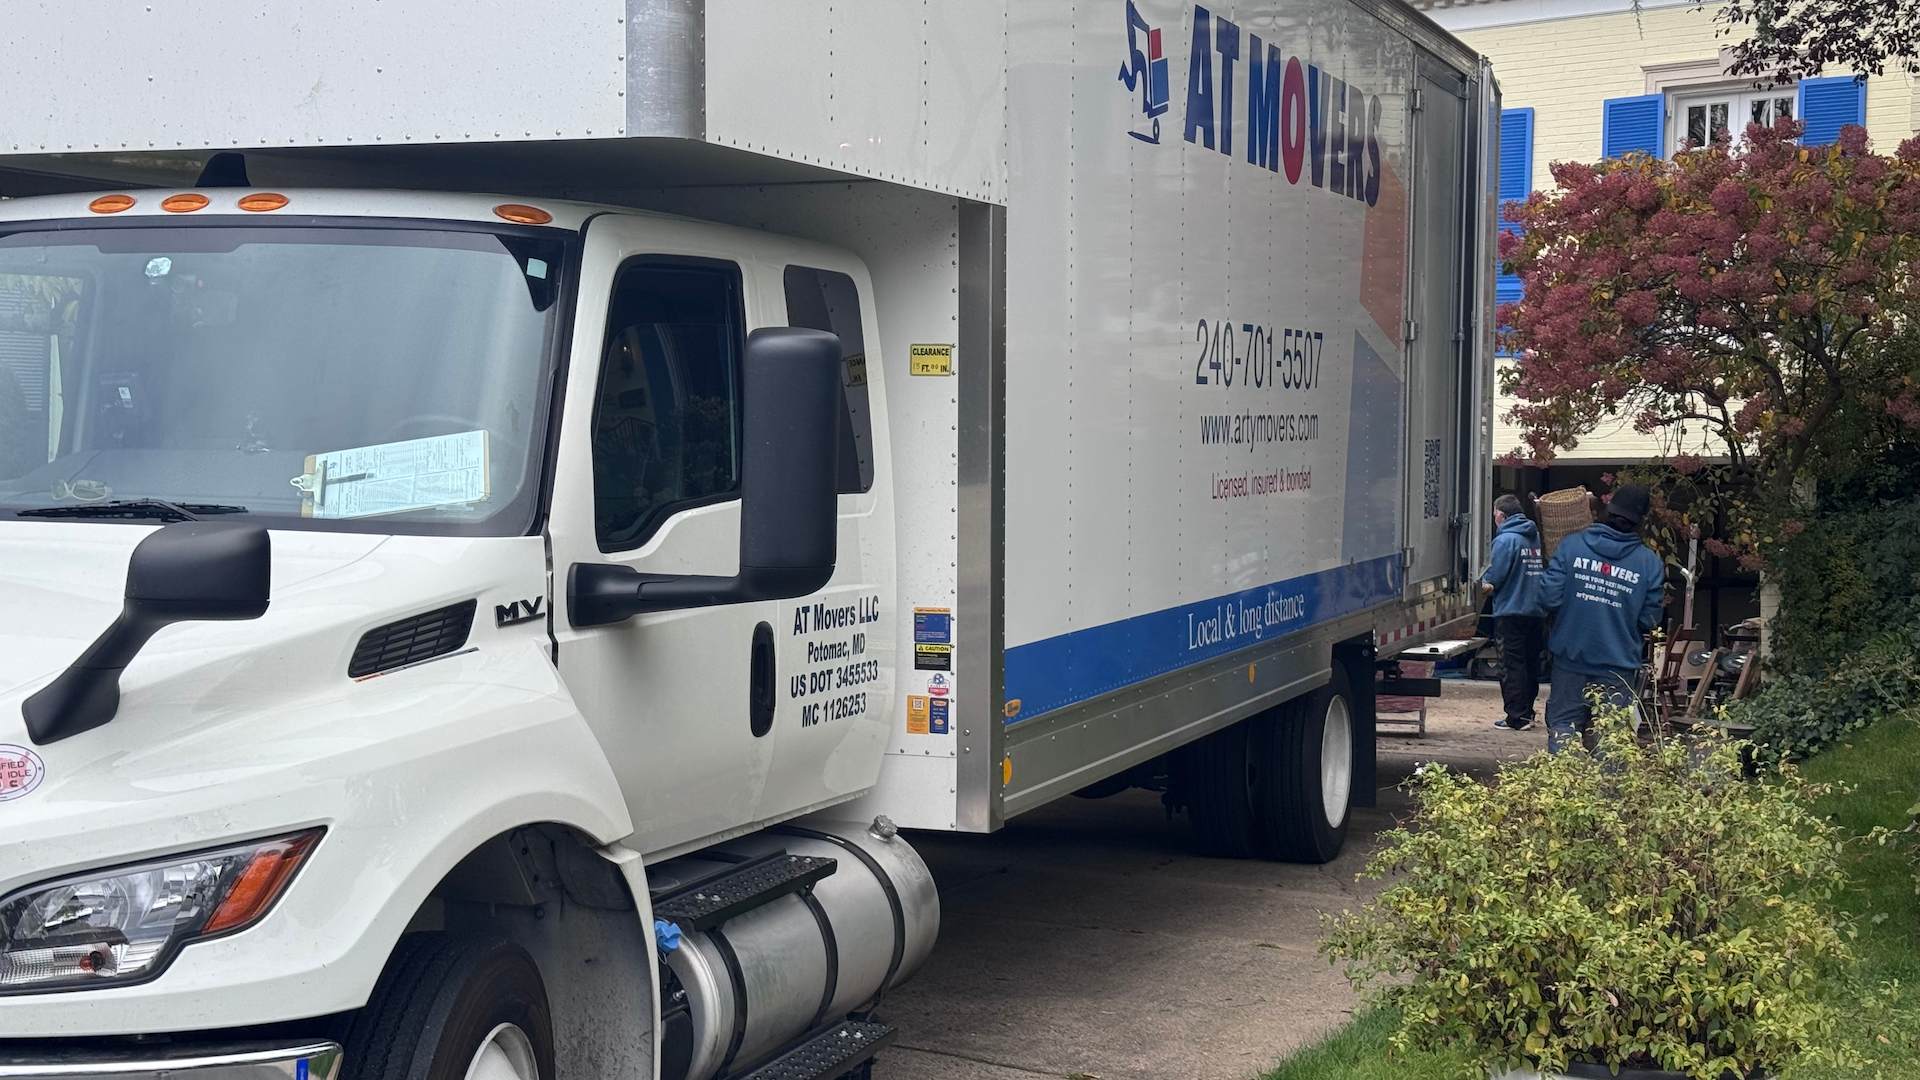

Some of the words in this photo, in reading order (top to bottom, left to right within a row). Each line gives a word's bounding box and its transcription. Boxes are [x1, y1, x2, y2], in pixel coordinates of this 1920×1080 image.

[1184, 4, 1240, 157] AT
[1247, 32, 1382, 208] MOVERS
[912, 347, 949, 356] CLEARANCE
[1195, 318, 1323, 390] 240-701-5507
[1200, 410, 1319, 453] www.artymovers.com
[1251, 467, 1278, 495] insured
[1279, 468, 1285, 492] &
[1286, 465, 1312, 492] bonded
[1573, 557, 1590, 570] AT
[1590, 560, 1640, 584] MOVERS
[495, 595, 543, 627] MV
[793, 605, 810, 636] AT
[813, 603, 856, 631] Movers
[859, 595, 879, 624] LLC
[1188, 606, 1221, 650] Local
[1225, 602, 1236, 640] &
[1239, 600, 1262, 639] long
[1264, 591, 1305, 626] distance
[808, 640, 850, 664] Potomac,
[852, 632, 865, 655] MD
[791, 674, 806, 698] US
[810, 668, 833, 694] DOT
[836, 659, 878, 689] 3455533
[802, 702, 819, 728] MC
[823, 692, 866, 722] 1126253
[8, 769, 32, 779] IDLE
